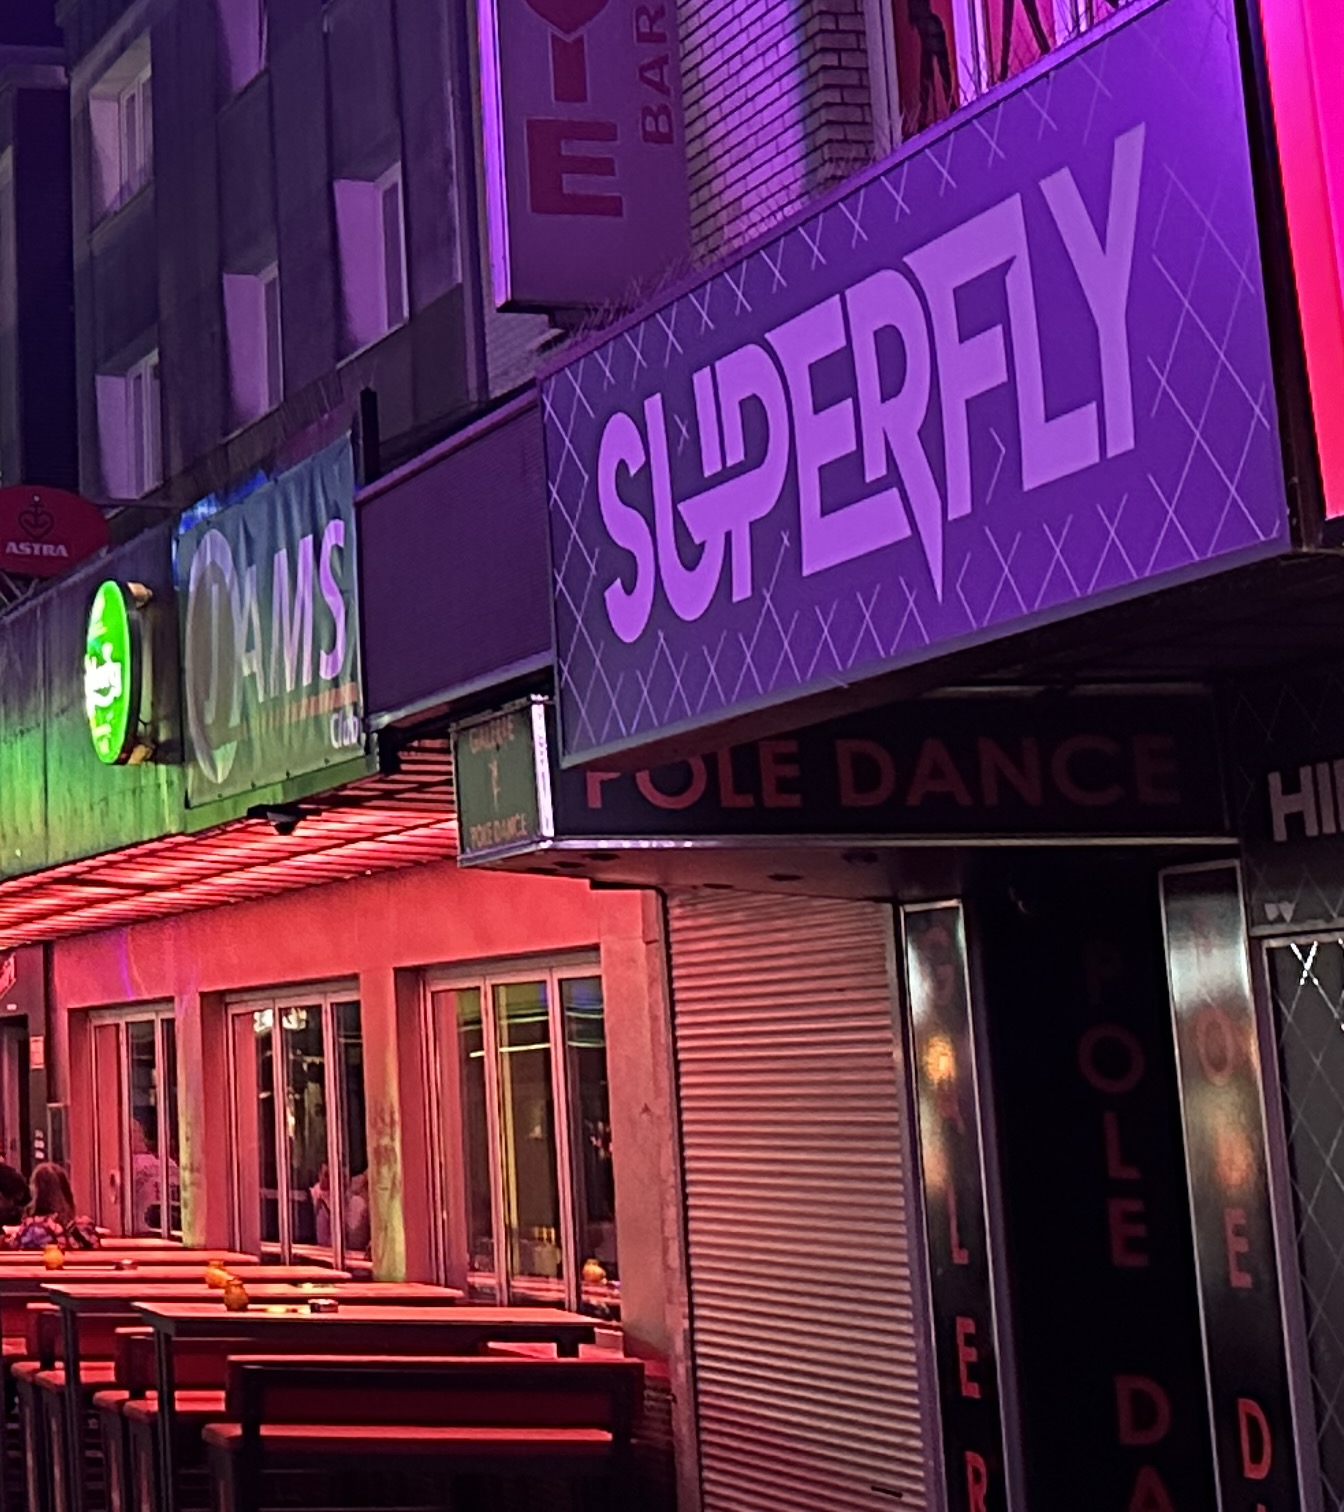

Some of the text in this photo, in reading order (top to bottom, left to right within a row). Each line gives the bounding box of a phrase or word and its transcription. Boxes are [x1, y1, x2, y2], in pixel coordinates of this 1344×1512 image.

[634, 3, 675, 146] BAR
[598, 122, 1146, 644] SUPERFLY
[5, 540, 70, 558] ASTRA
[330, 712, 360, 749] Club
[587, 734, 1180, 810] POLE DANCE
[1268, 759, 1344, 842] HI
